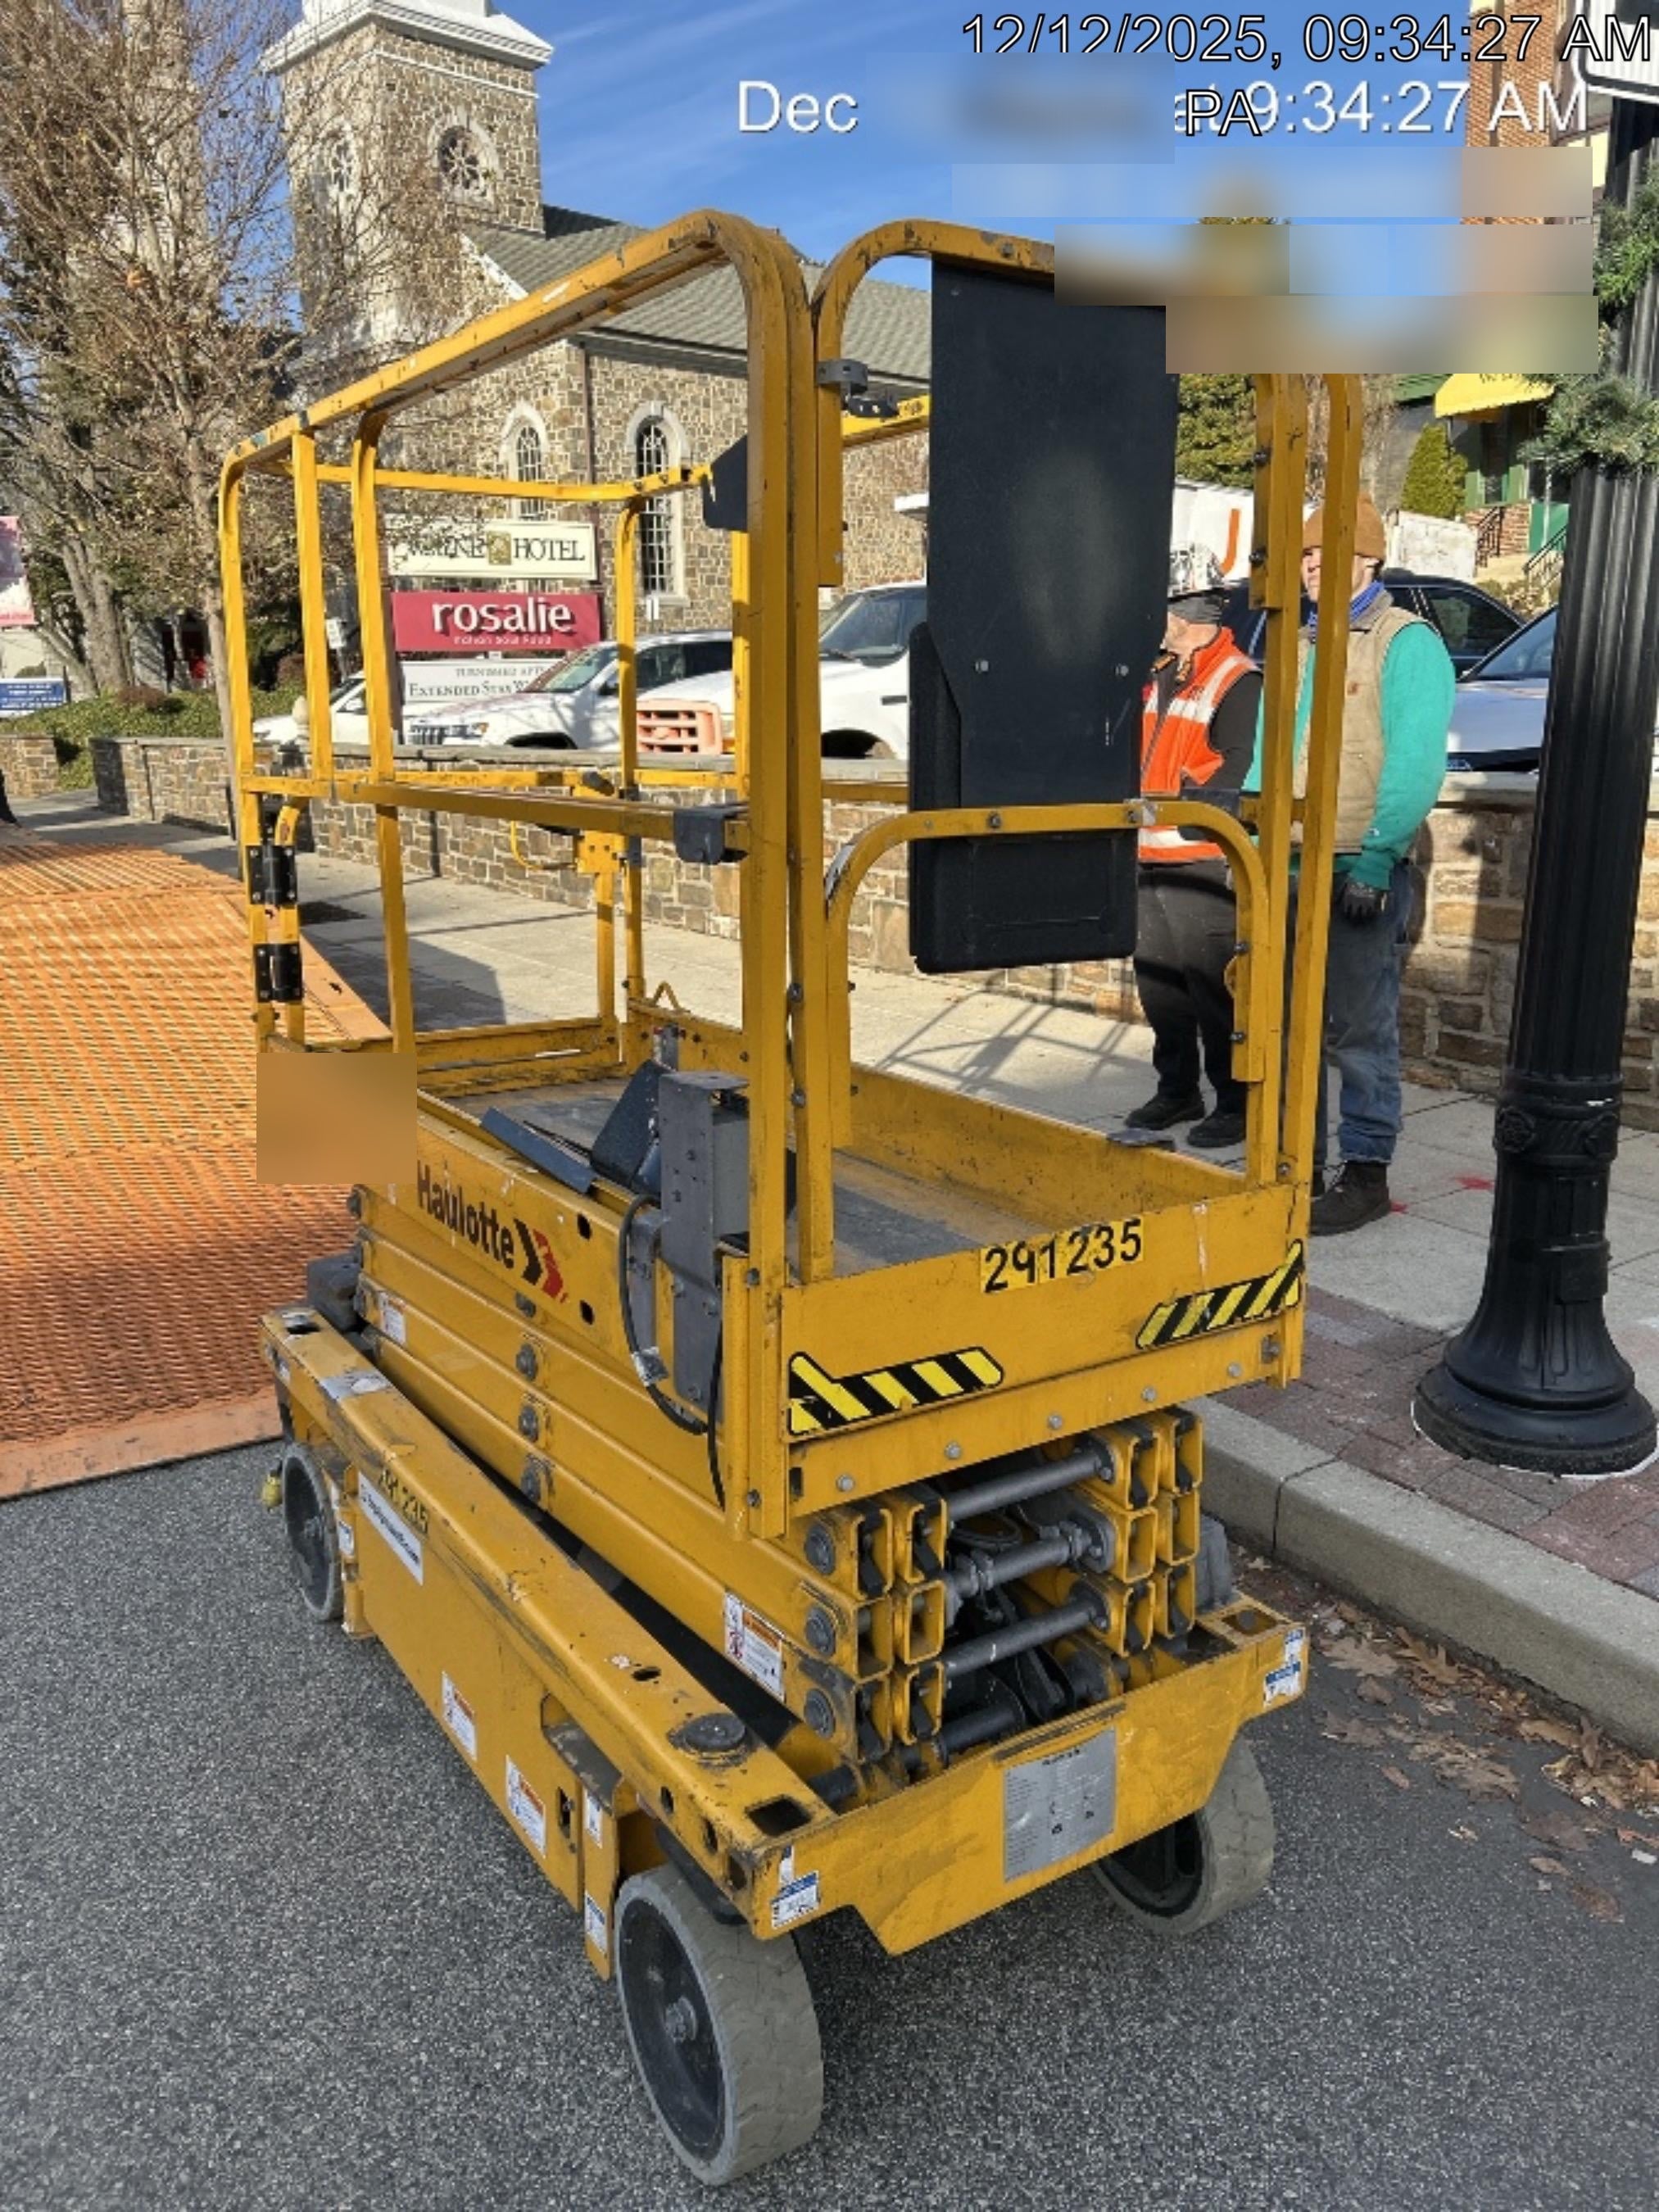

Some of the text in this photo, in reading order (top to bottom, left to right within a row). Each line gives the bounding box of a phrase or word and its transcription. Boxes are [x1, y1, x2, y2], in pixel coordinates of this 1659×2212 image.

[513, 537, 586, 561] HOTEL
[432, 596, 572, 632] rosalie
[416, 1160, 514, 1269] Haulotte
[985, 1217, 1142, 1294] 291235
